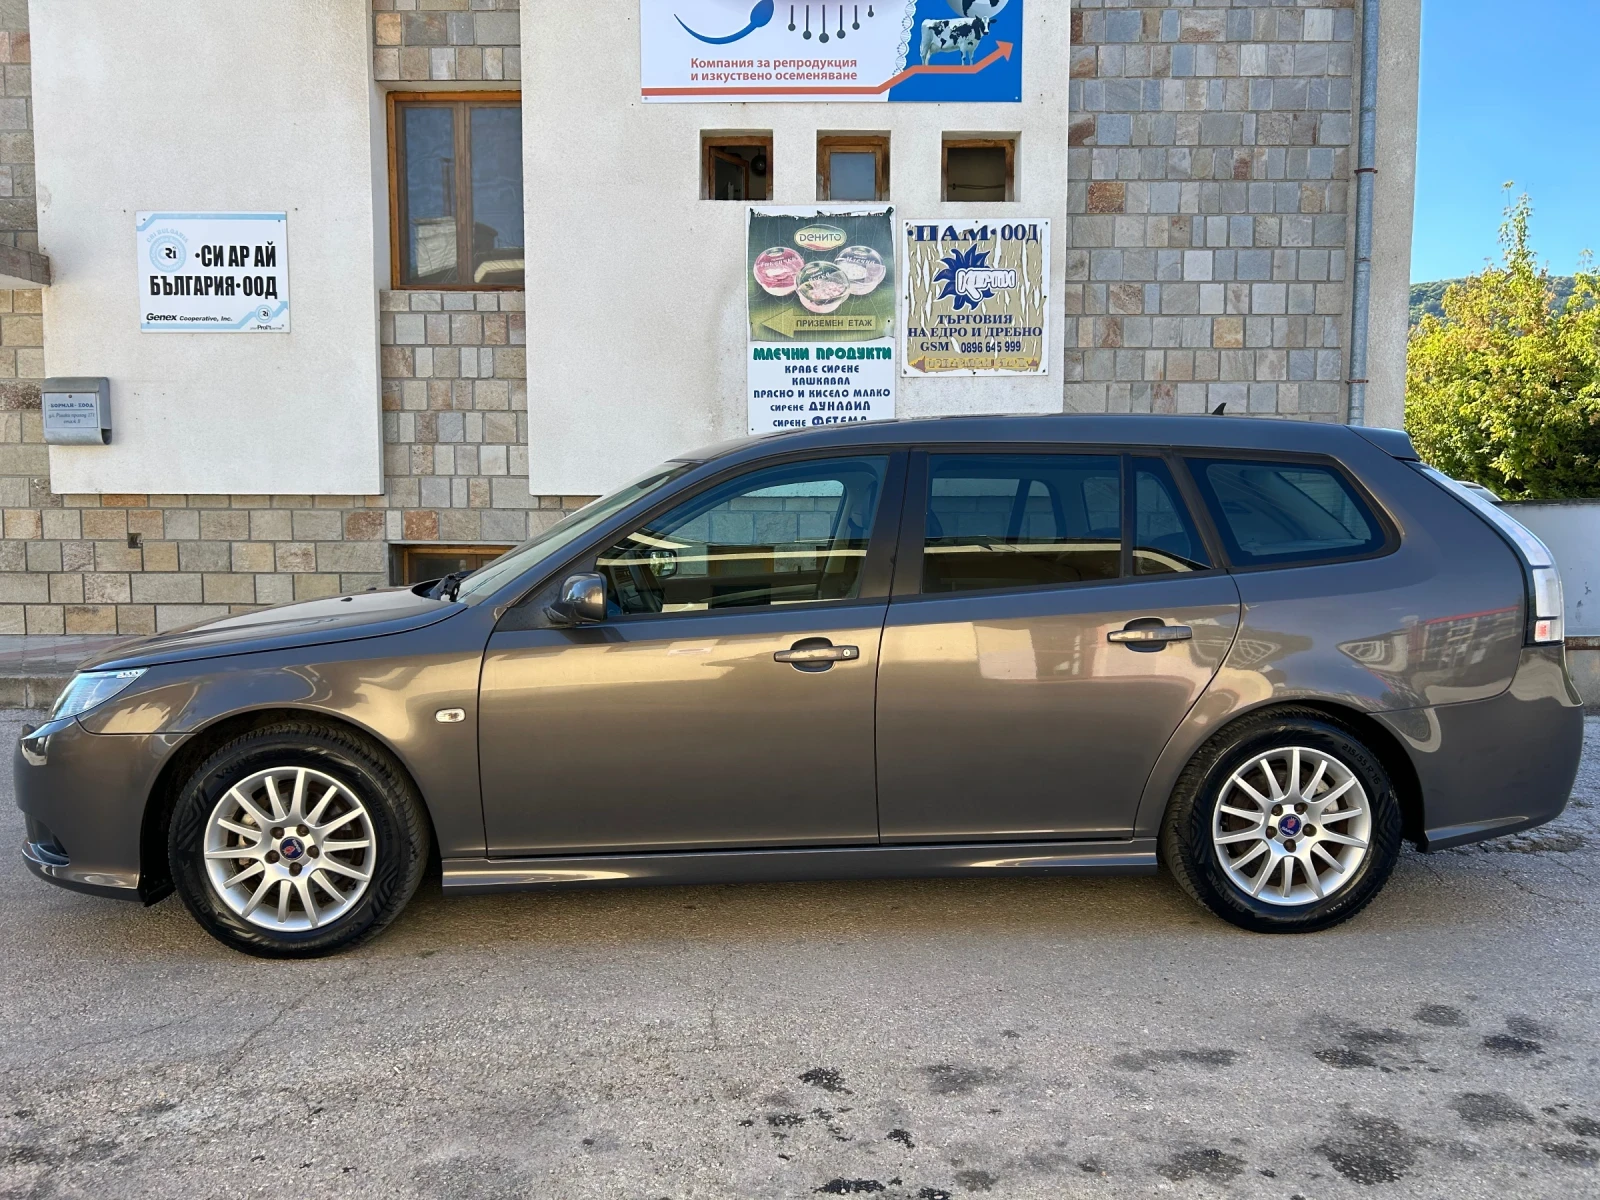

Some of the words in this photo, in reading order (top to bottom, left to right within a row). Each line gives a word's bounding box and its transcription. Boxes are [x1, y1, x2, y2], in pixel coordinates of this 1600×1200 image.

[691, 58, 754, 69] Компания
[757, 60, 770, 68] за
[773, 58, 857, 71] репродукция
[691, 73, 698, 81] и
[701, 72, 773, 82] изкуствено
[775, 72, 857, 81] осеменяване
[1001, 224, 1038, 244] ООД
[228, 244, 250, 267] АР
[254, 241, 277, 268] АЙ
[146, 312, 178, 321] Genex
[179, 315, 220, 323] Cooperative,
[937, 314, 1013, 324] ТЪРГОВИЯ
[796, 319, 844, 327] ПРИЗЕМЕН
[848, 319, 873, 327] ЕТАЖ
[908, 327, 927, 337] НА
[930, 327, 967, 339] ЕДРО
[971, 327, 981, 337] И
[985, 326, 1043, 338] ДРЕБНО
[920, 341, 949, 352] GSM
[961, 342, 982, 353] 0896
[1005, 341, 1021, 352] 999
[753, 347, 809, 360] МЛЕЧНИ
[816, 347, 892, 360] ПРОДУКТИ
[784, 365, 818, 373] КРАВЕ
[821, 365, 860, 373] СИРЕНЕ
[792, 377, 851, 385] КАШКАВАЛ
[754, 389, 794, 398] ПРЯСНО
[798, 389, 805, 398] И
[809, 389, 850, 398] КИСЕЛО
[770, 404, 804, 412] СИРЕНЕ
[772, 419, 806, 427] СИРЕНЕ
